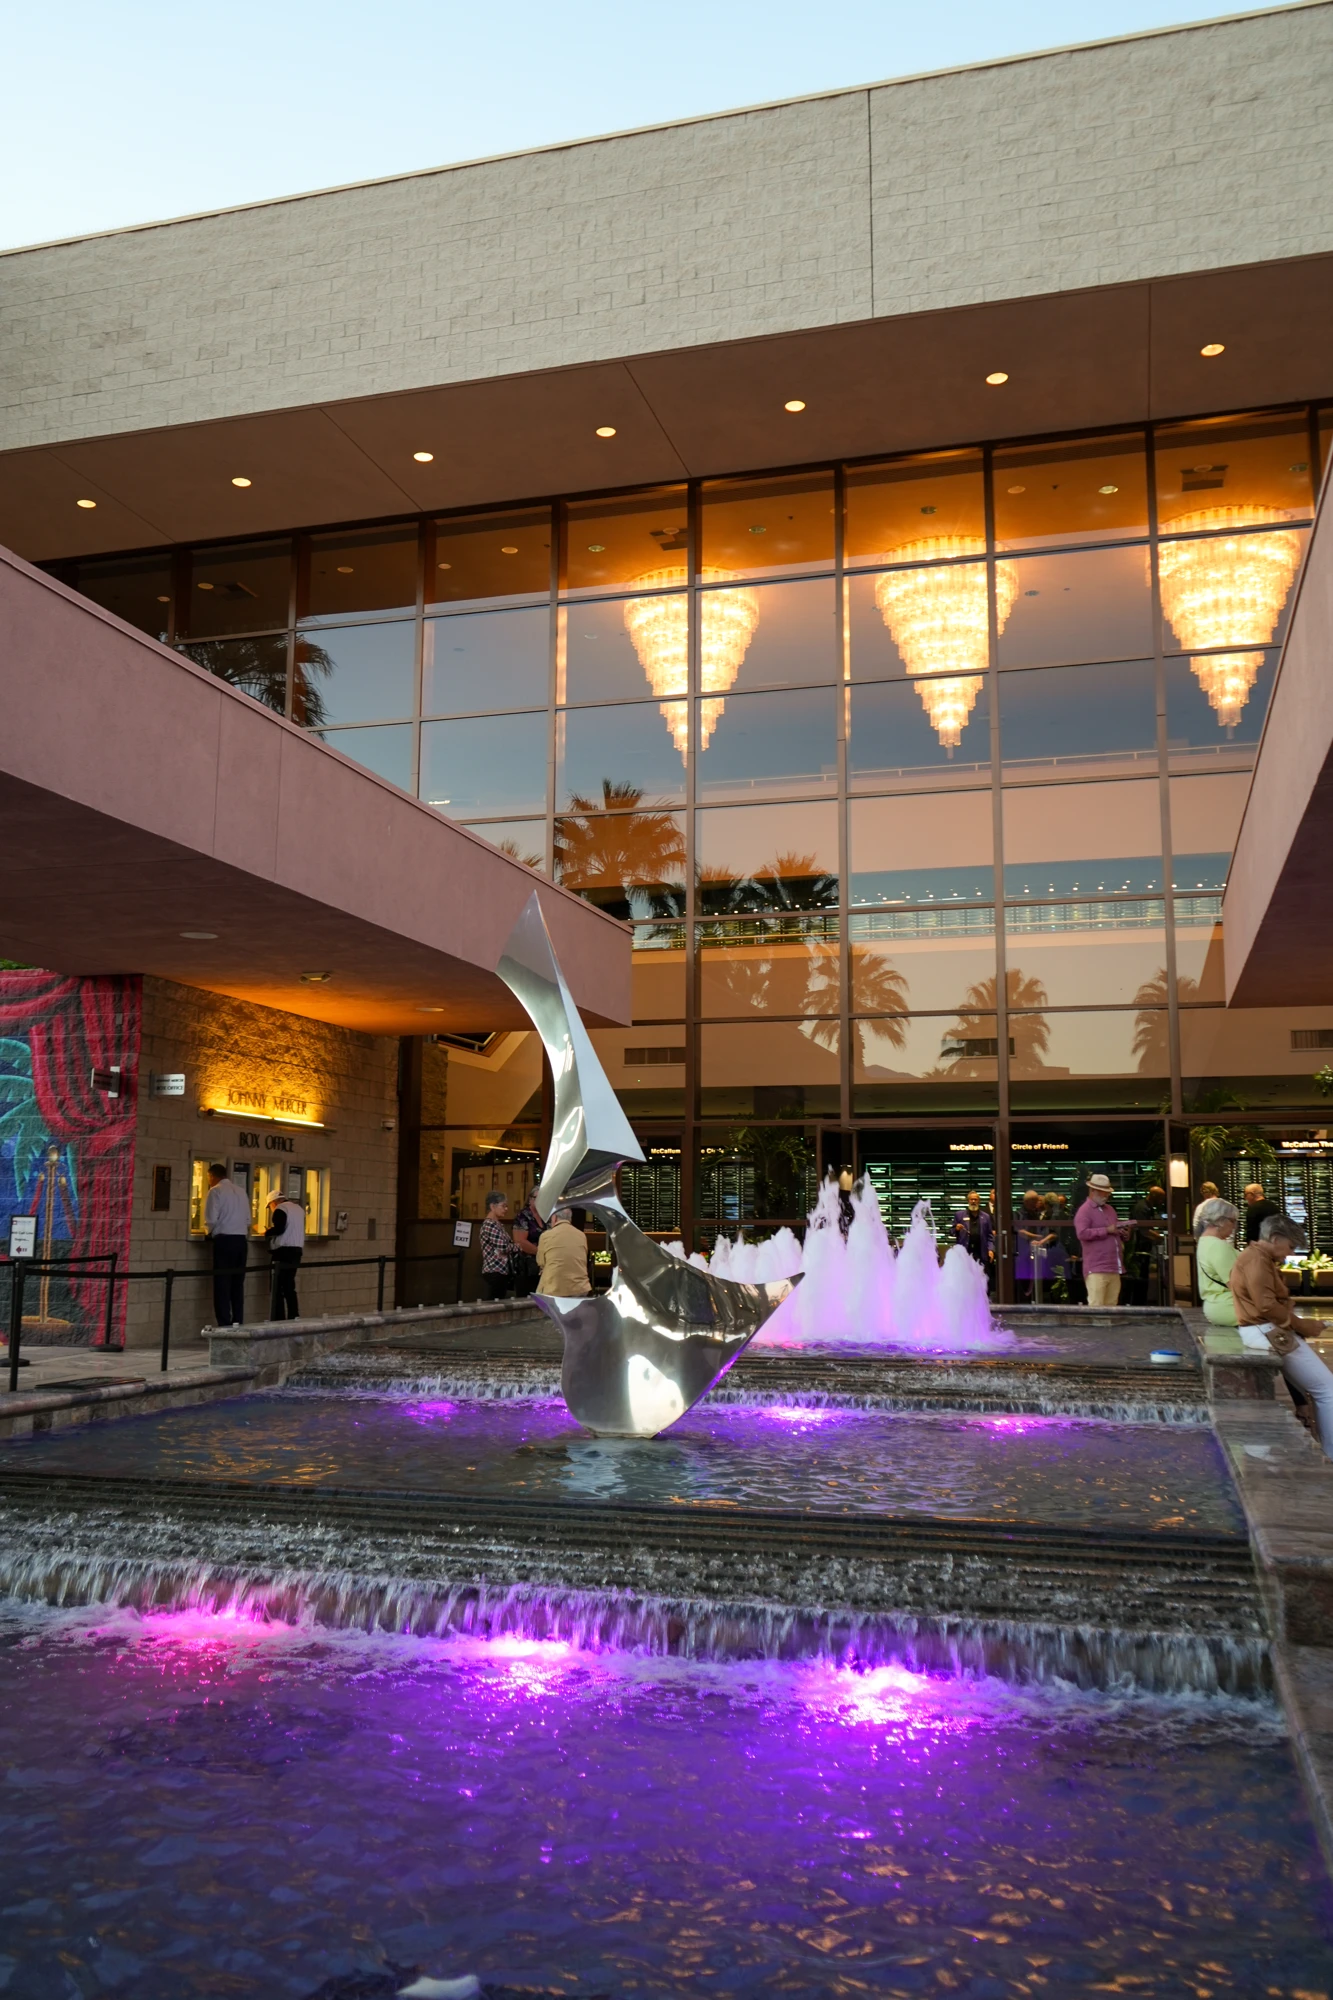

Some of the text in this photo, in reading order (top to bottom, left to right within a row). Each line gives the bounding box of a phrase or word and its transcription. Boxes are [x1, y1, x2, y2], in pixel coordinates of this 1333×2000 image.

[226, 1088, 307, 1115] JOHNNY MERCER
[239, 1131, 295, 1153] BOX OFFICE
